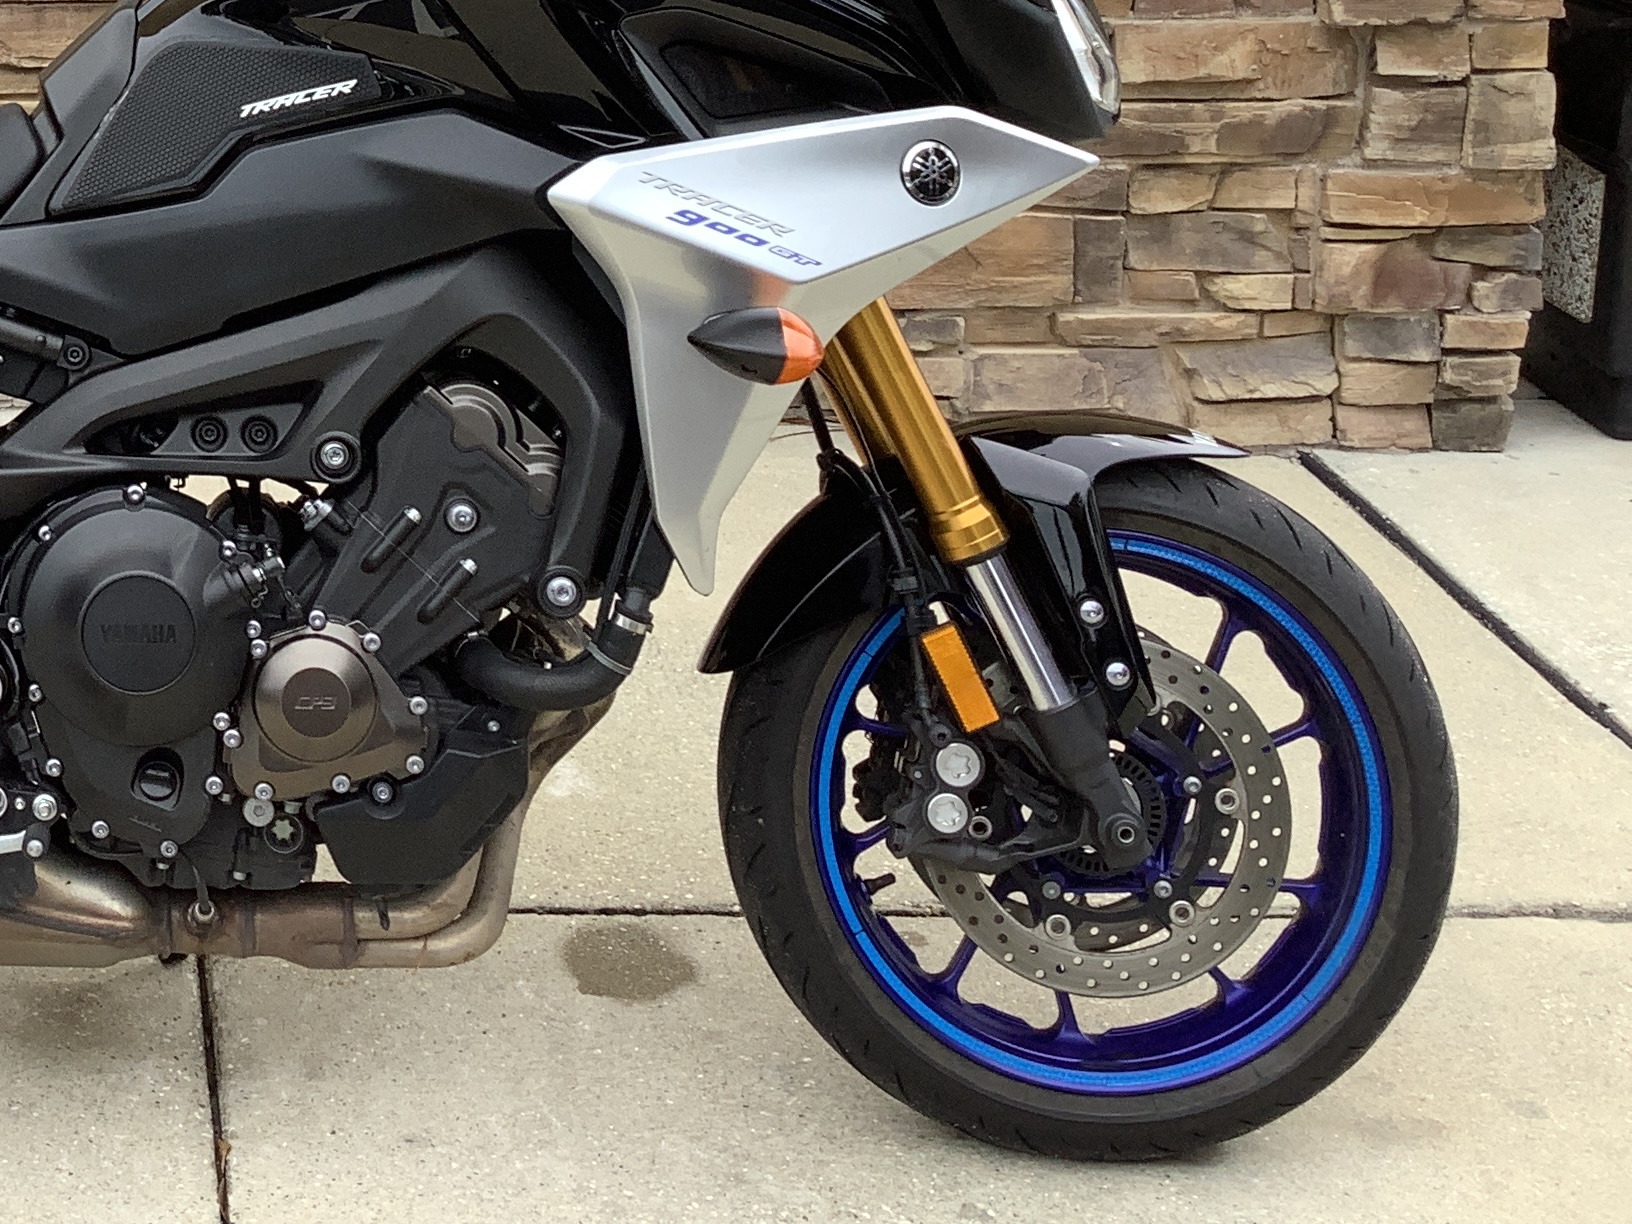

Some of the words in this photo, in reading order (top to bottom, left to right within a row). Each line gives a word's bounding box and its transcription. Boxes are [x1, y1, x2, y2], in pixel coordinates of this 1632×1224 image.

[239, 78, 358, 118] TRACER
[638, 170, 796, 238] TRACER
[666, 209, 770, 247] 900
[99, 623, 177, 644] YAMAHA
